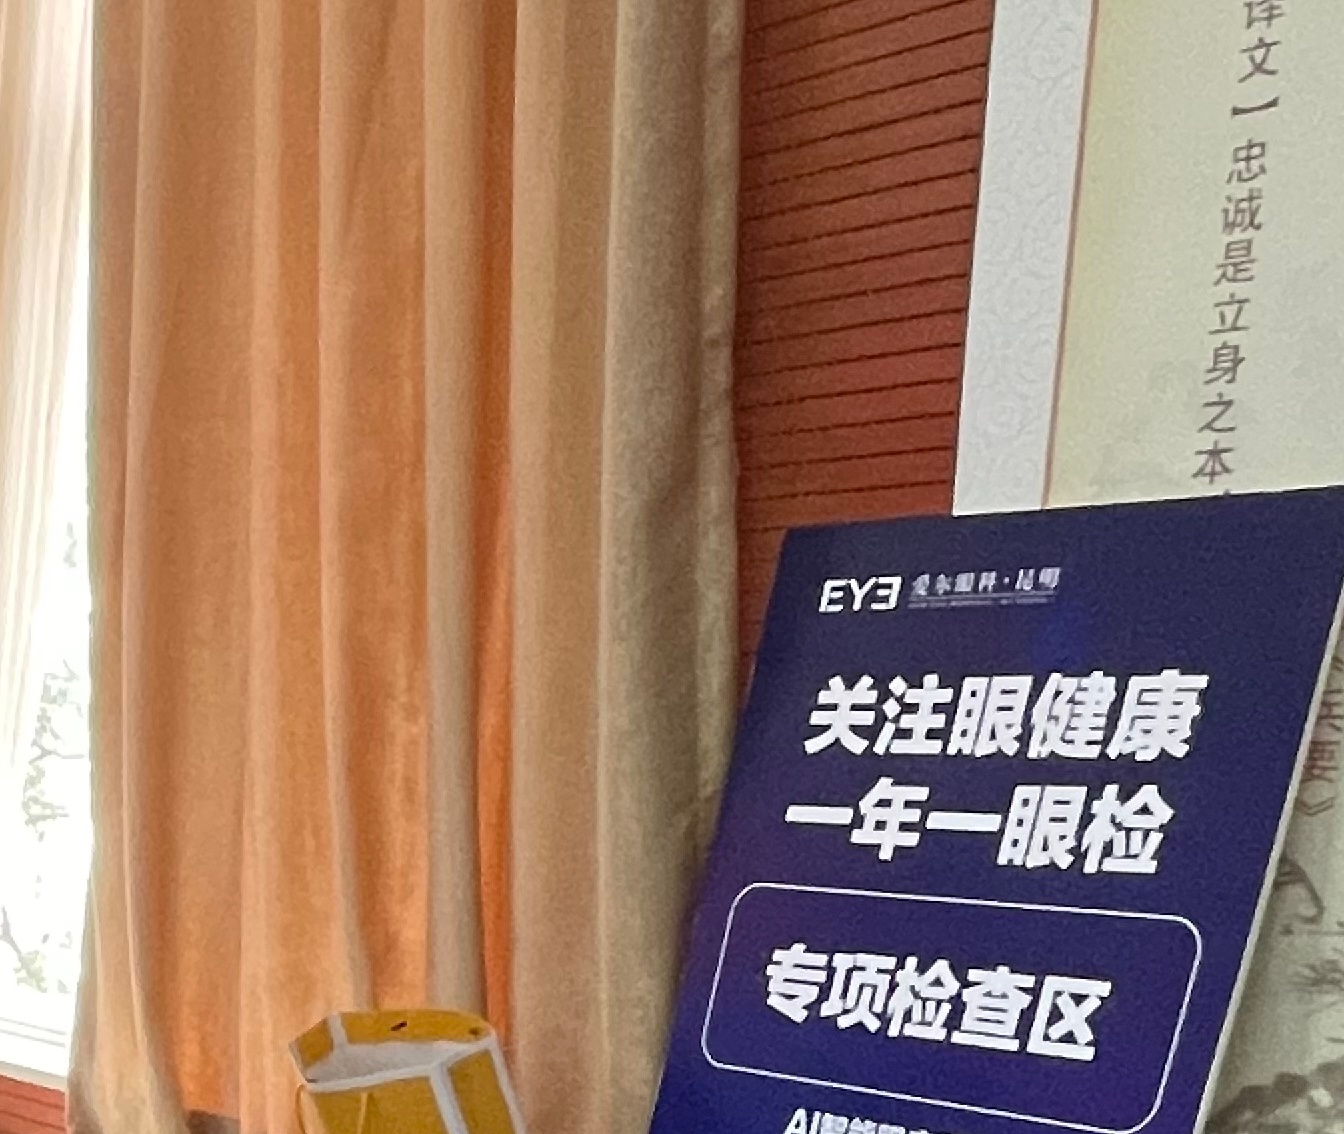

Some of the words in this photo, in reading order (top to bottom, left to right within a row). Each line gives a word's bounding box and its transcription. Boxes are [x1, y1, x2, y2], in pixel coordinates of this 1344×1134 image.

[803, 668, 1209, 762] 关注眼健康
[784, 777, 1175, 874] 一年一眼检
[764, 943, 1112, 1061] 专项检查区
